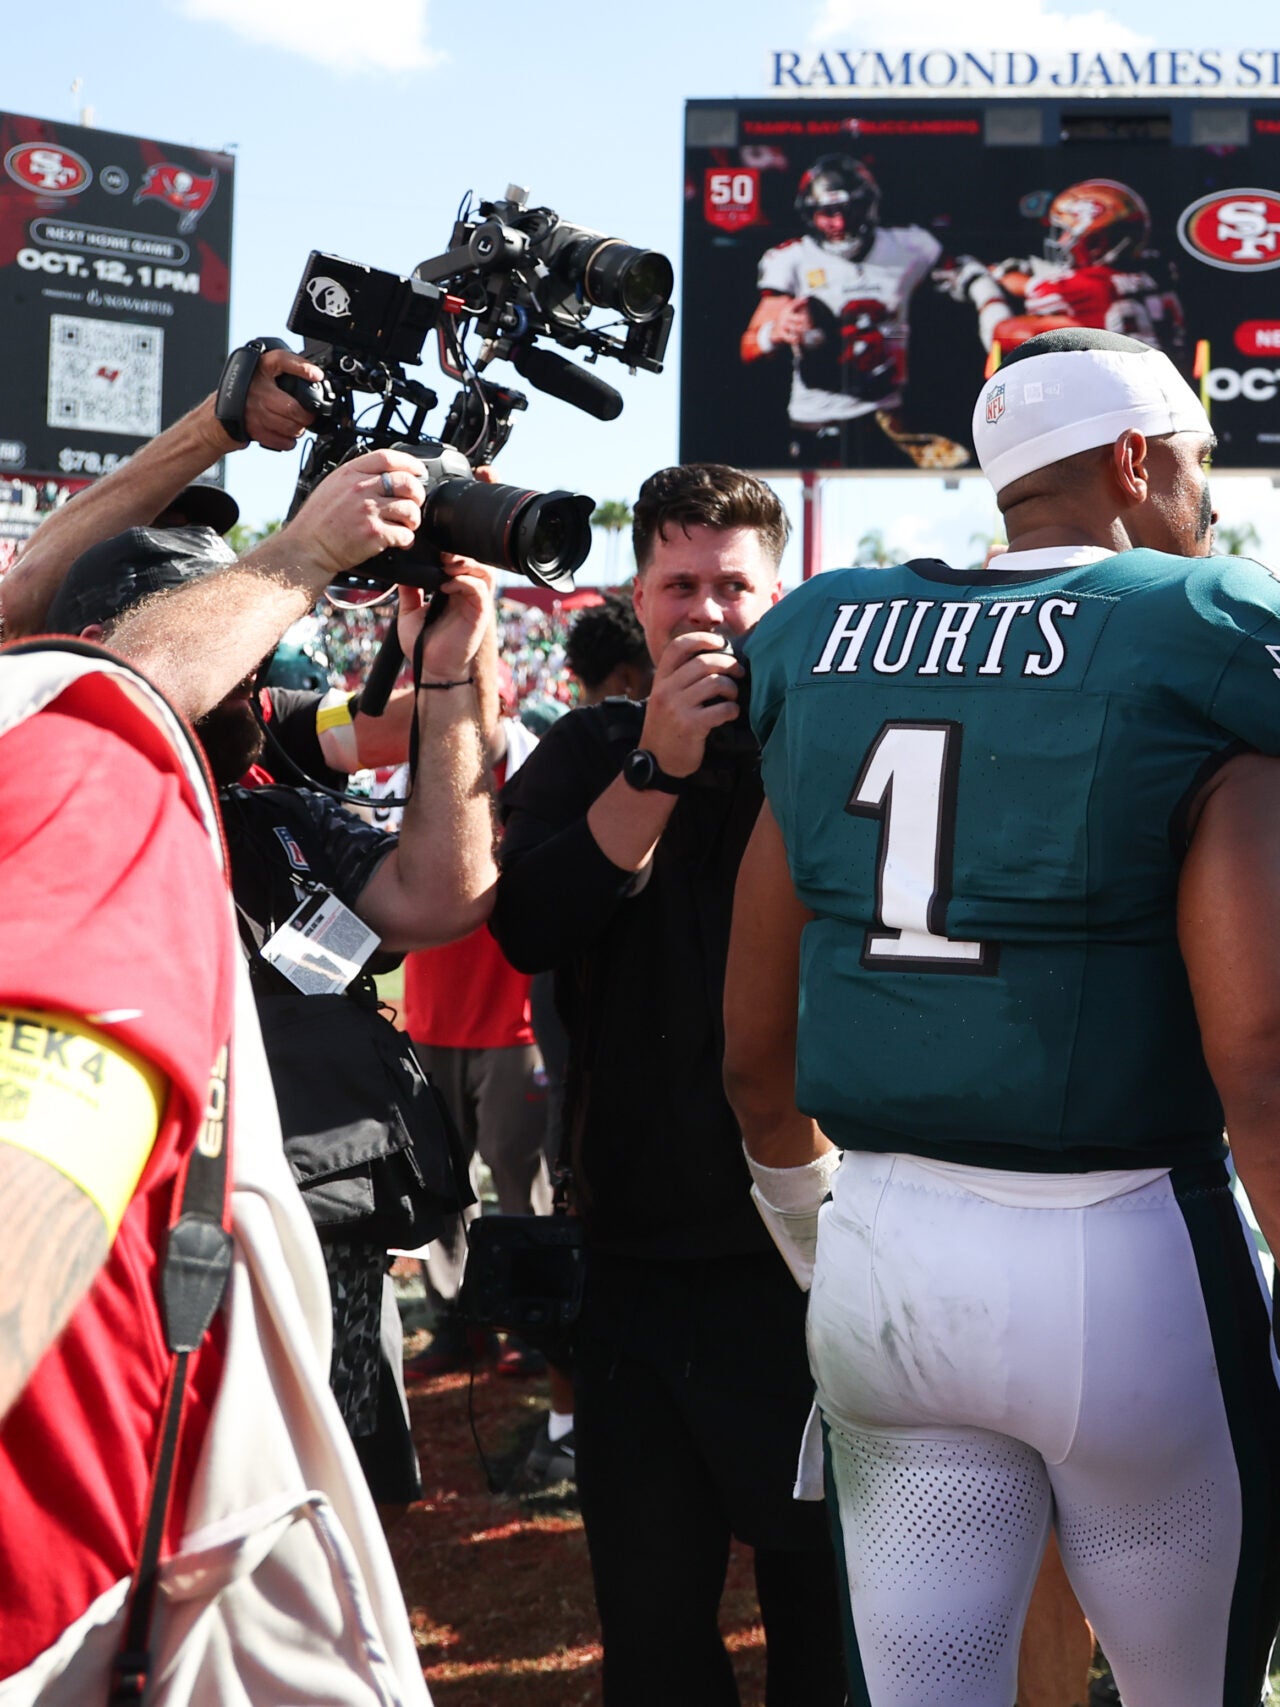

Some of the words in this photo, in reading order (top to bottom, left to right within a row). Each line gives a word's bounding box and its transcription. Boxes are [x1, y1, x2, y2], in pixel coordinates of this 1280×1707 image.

[771, 51, 1039, 86] RAYMOND
[1051, 51, 1221, 87] JAMES
[710, 174, 753, 205] 50
[17, 248, 89, 278] OCT.
[93, 259, 133, 287] 12,
[138, 266, 152, 286] 1
[155, 268, 199, 294] PM
[987, 396, 1004, 420] NFL
[811, 596, 1077, 677] HURTS
[843, 720, 999, 977] 1
[0, 1015, 77, 1071] EK
[82, 1051, 107, 1084] 4
[198, 1044, 229, 1159] EOS
